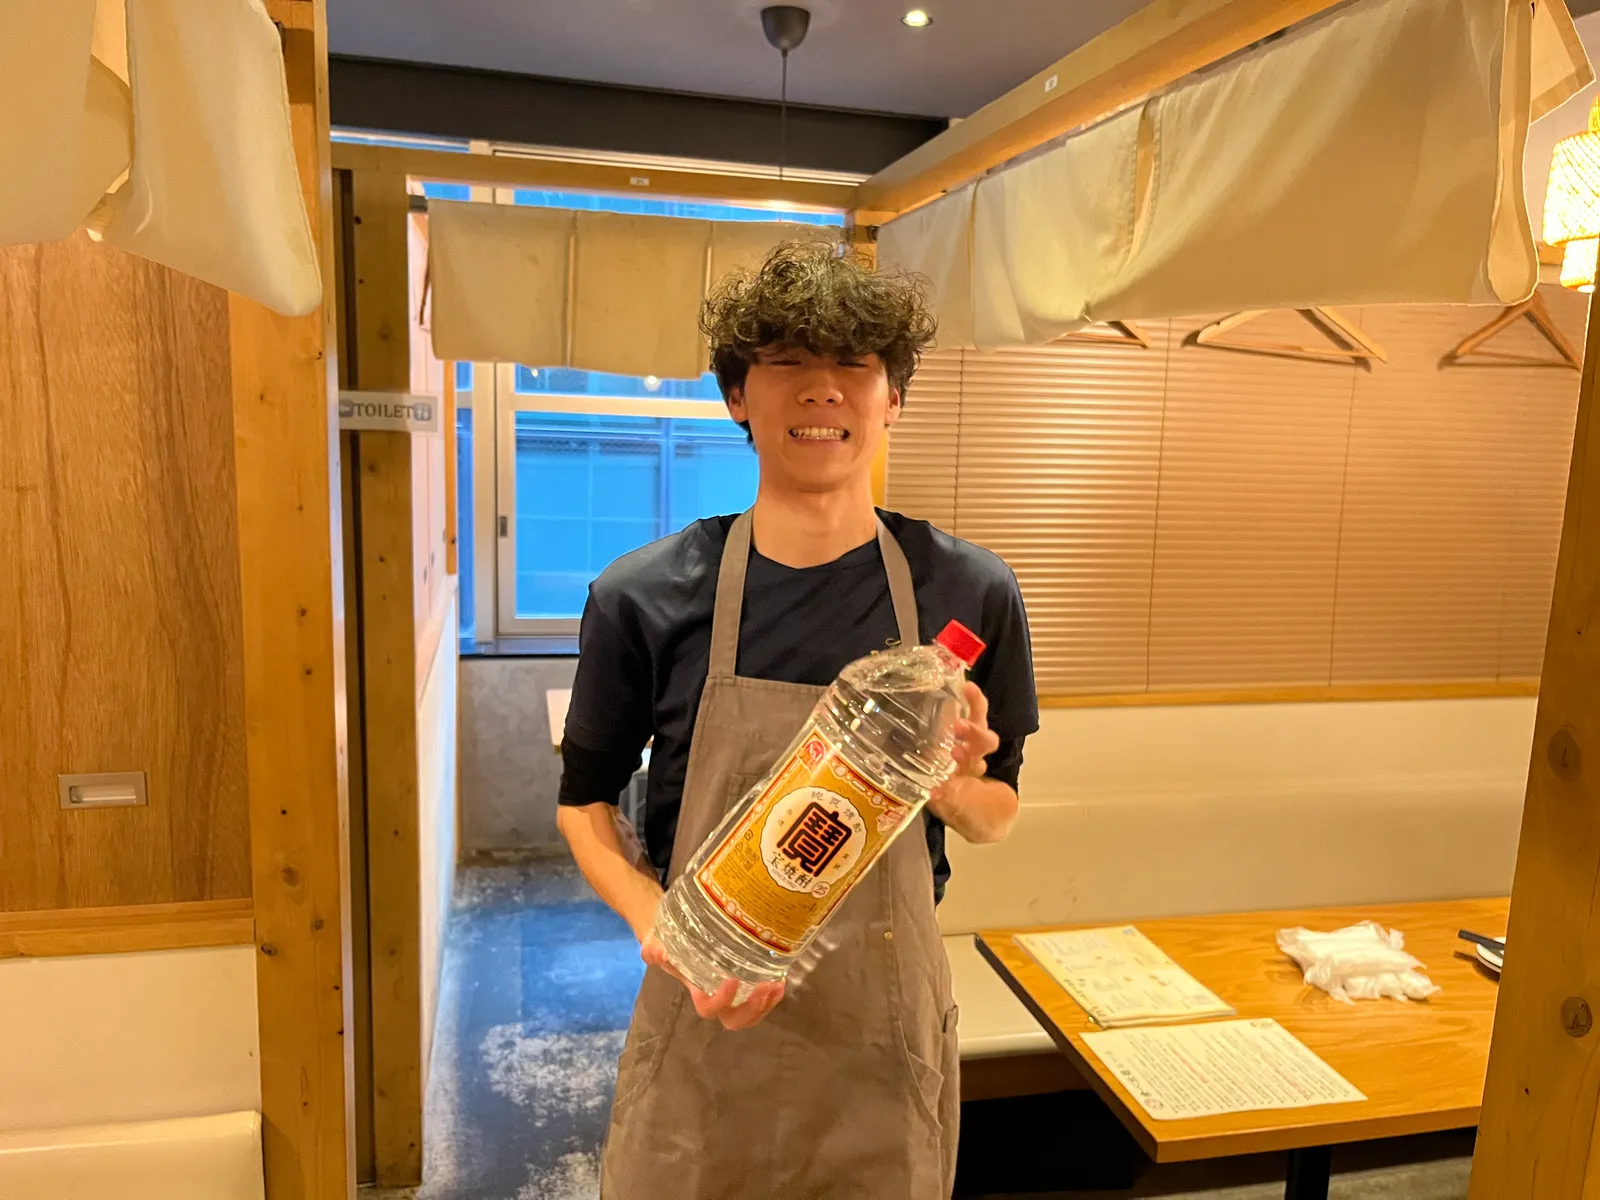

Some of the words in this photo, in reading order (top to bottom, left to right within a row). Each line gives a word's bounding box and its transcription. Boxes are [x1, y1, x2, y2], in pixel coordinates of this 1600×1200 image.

[354, 403, 414, 419] TOILET
[768, 852, 813, 889] 宝焼酎
[813, 882, 829, 897] 25
